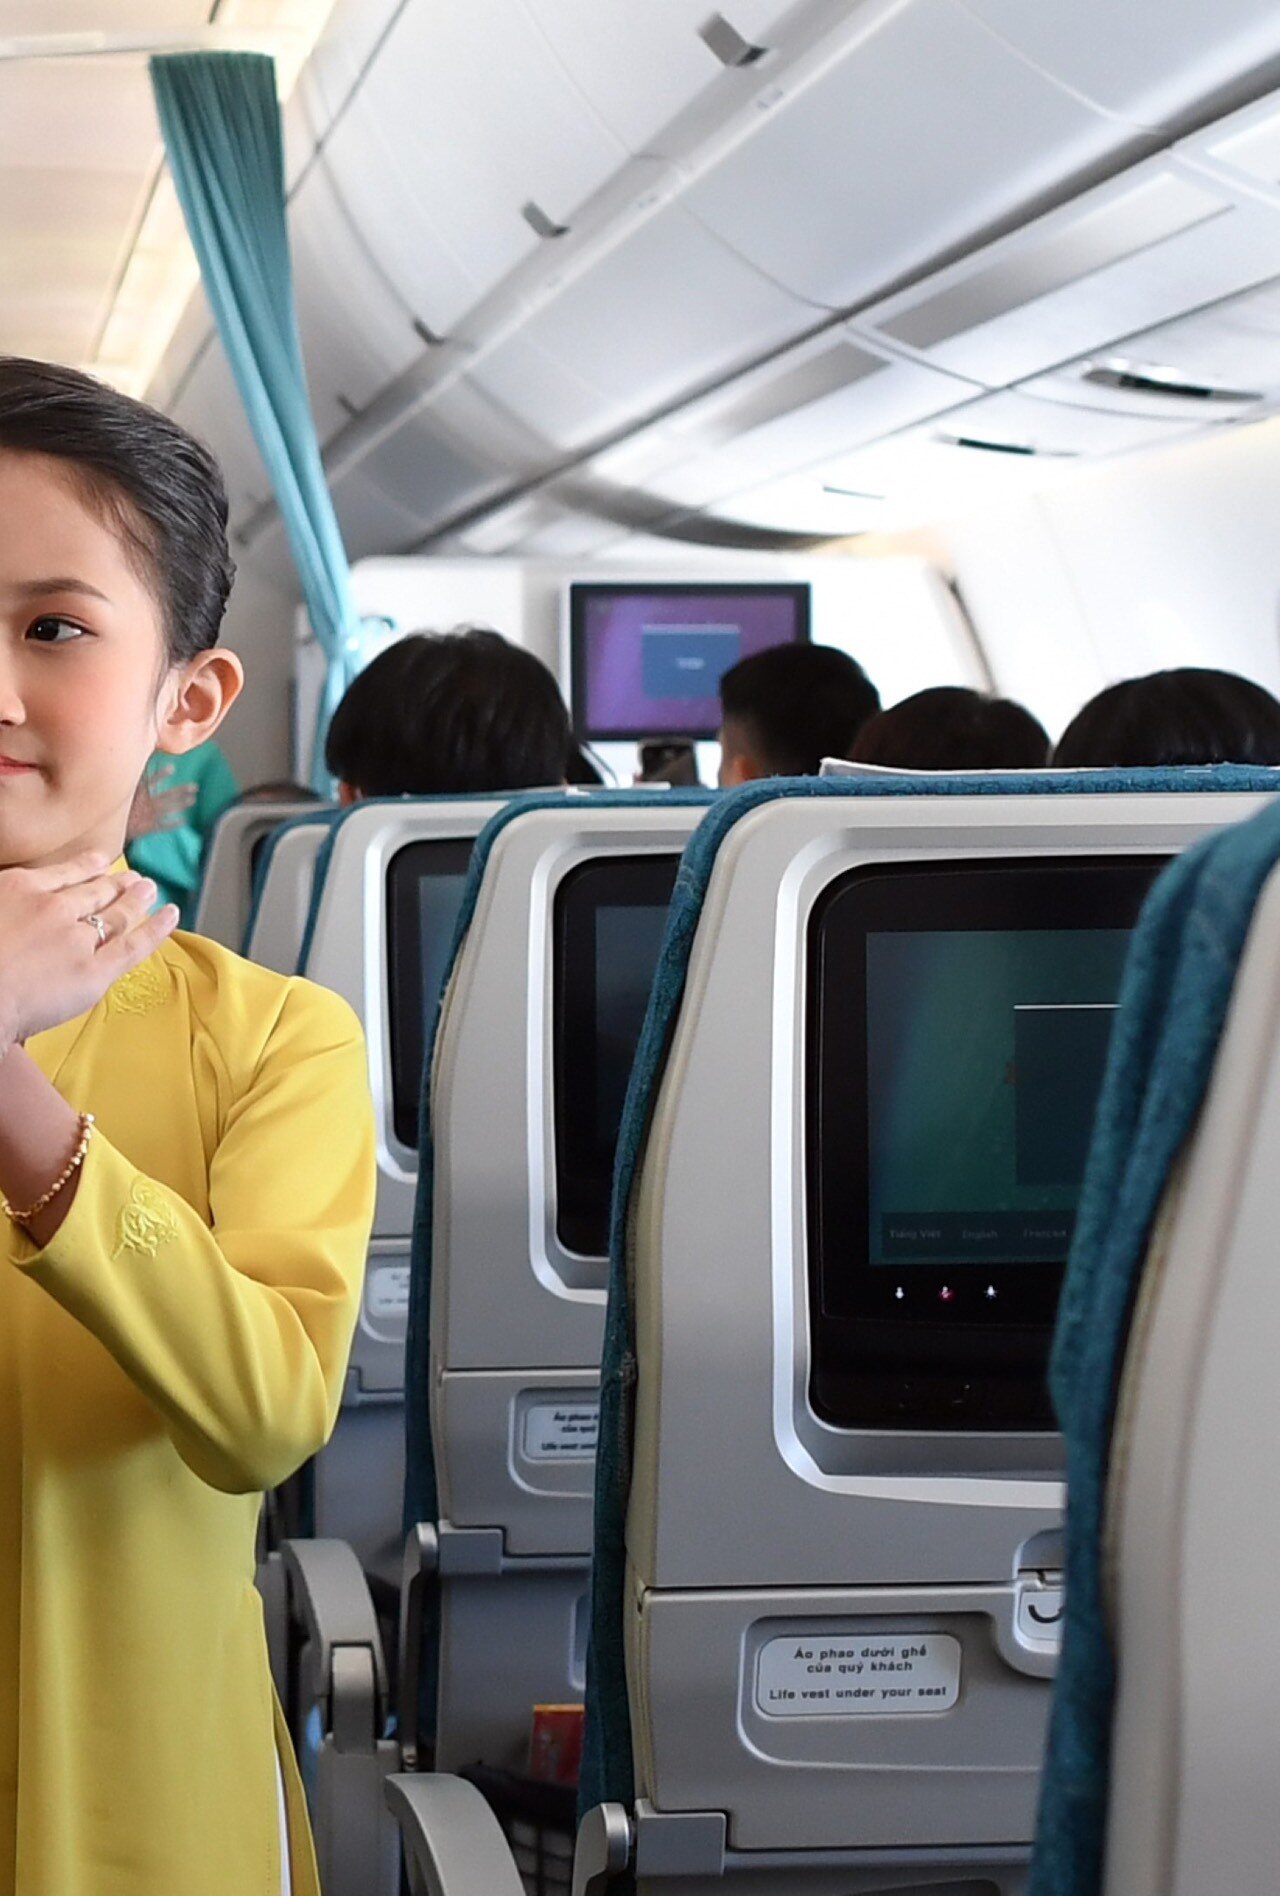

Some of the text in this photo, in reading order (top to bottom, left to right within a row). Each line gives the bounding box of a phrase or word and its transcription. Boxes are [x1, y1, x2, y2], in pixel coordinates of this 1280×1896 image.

[794, 1646, 813, 1659] Áo
[819, 1648, 854, 1661] phao
[901, 1644, 927, 1658] ghế
[806, 1661, 913, 1674] của quý khách
[769, 1686, 947, 1700] Life vest under your seat
